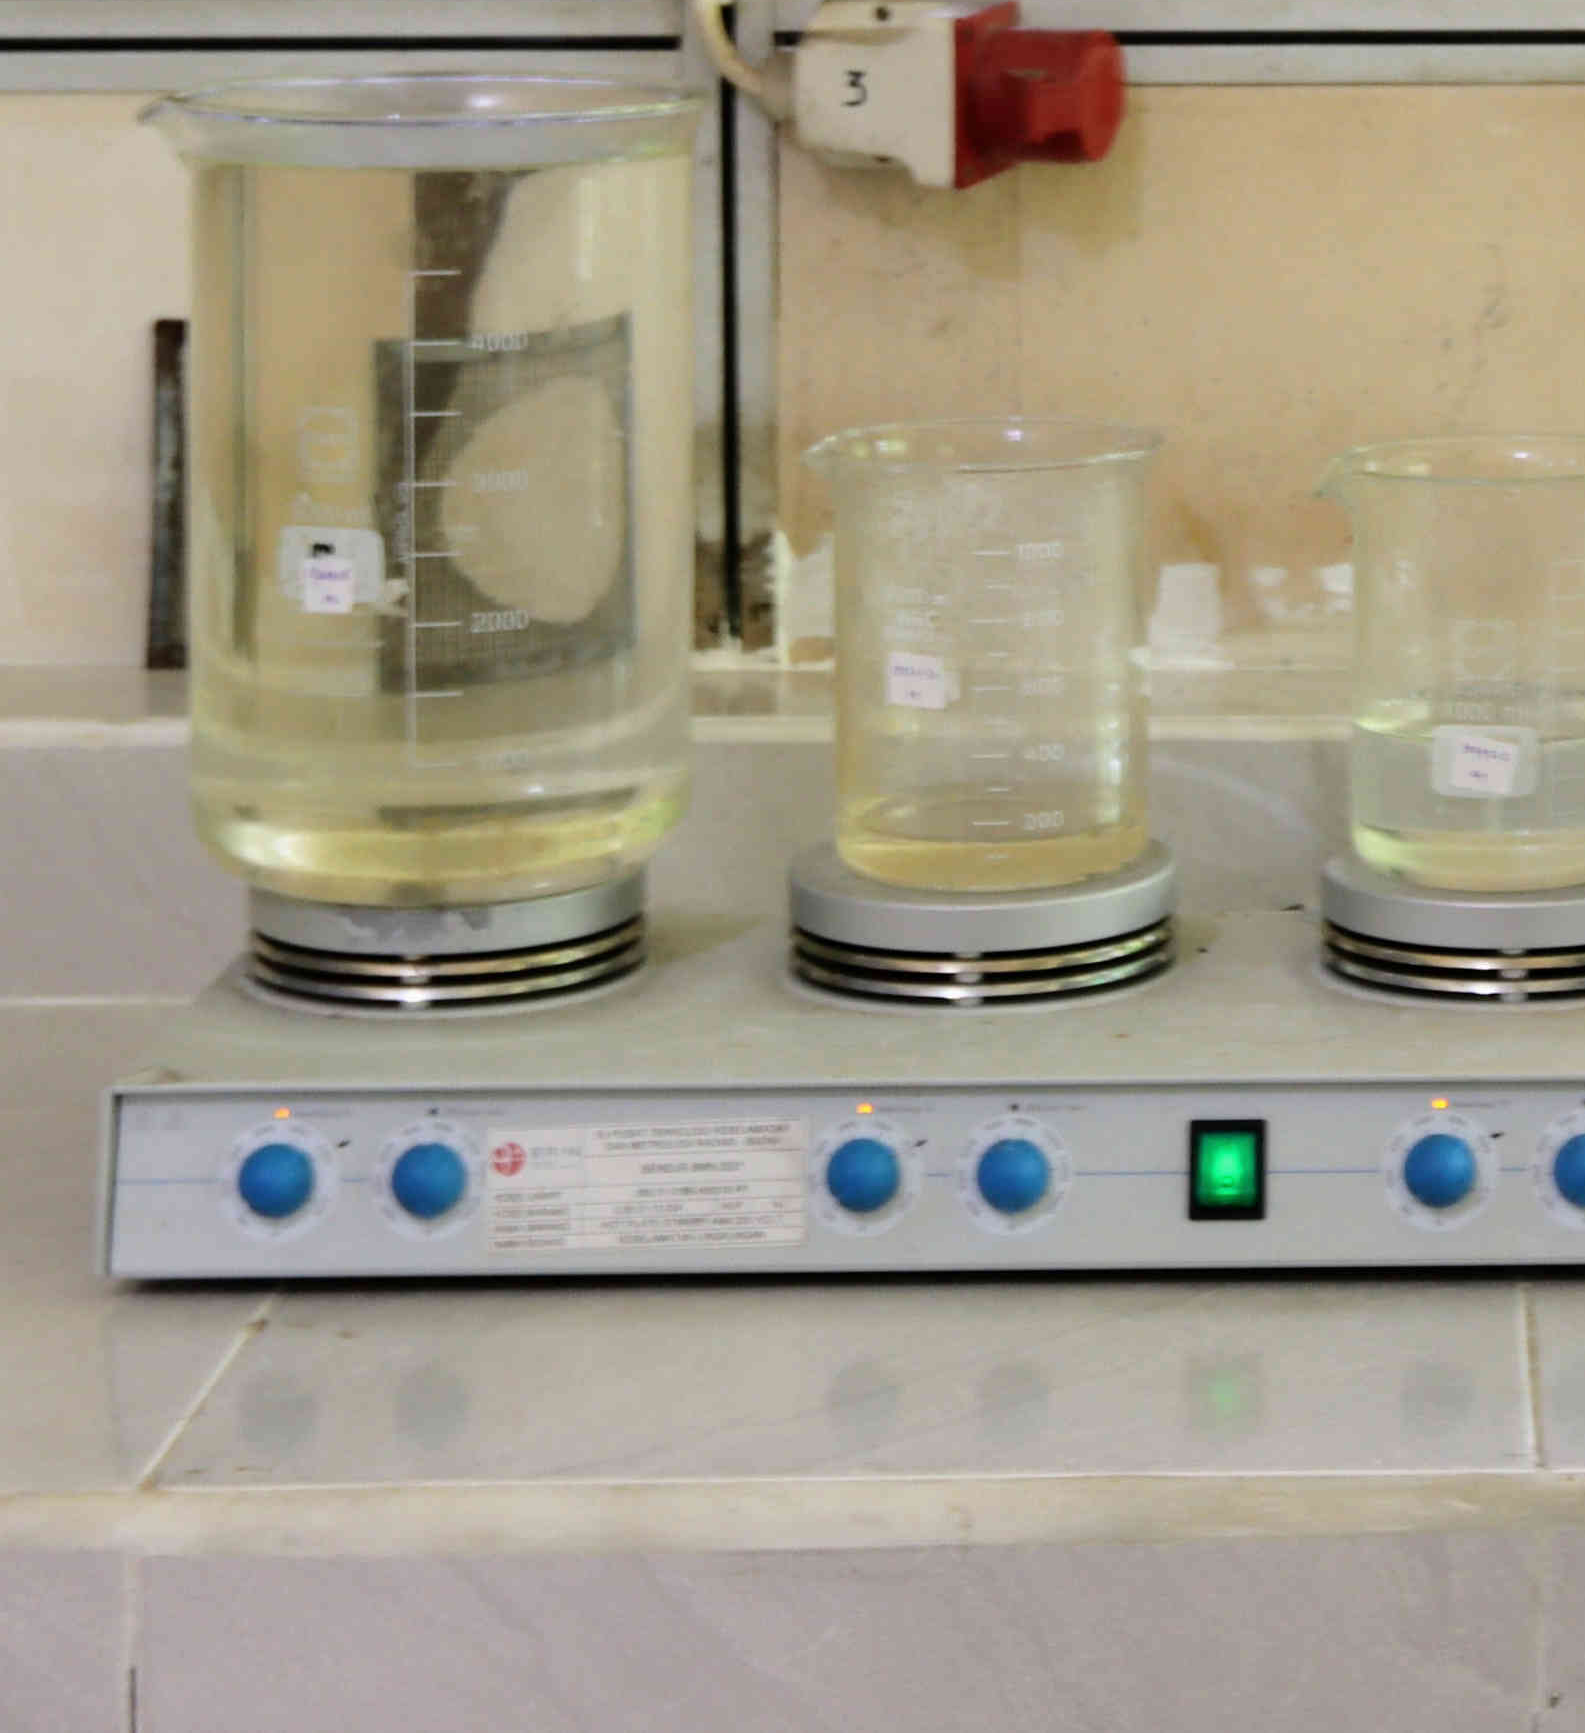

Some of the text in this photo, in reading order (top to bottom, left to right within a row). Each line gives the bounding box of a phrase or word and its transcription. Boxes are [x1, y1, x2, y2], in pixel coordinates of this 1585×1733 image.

[842, 71, 868, 107] 3
[468, 331, 528, 351] 4000
[470, 610, 529, 633] 2000
